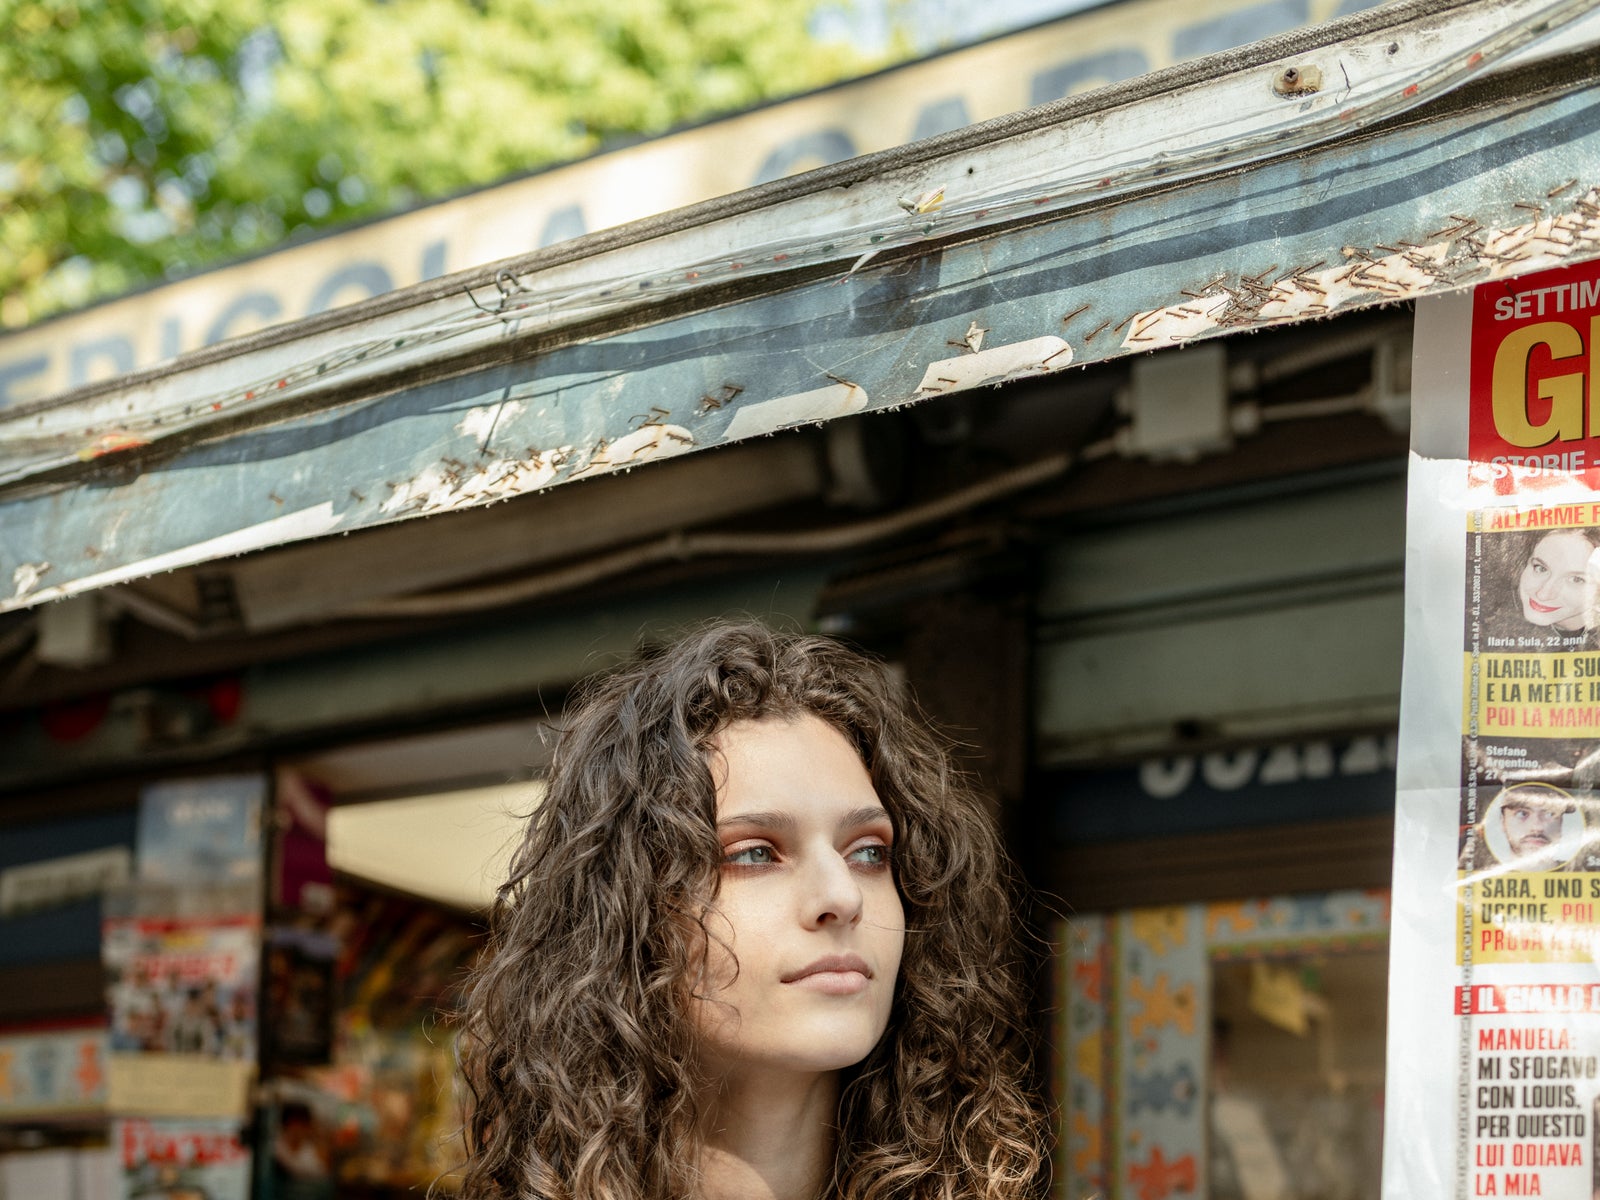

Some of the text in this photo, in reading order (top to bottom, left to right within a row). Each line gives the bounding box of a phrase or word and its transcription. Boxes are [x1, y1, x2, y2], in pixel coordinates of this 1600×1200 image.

[1491, 450, 1586, 479] STORIE
[1490, 504, 1585, 530] ALLARME
[1487, 636, 1515, 647] Ilaria
[1547, 636, 1561, 647] 22
[1487, 657, 1600, 681] ILARIA, IL SU
[1487, 683, 1495, 702] E
[1501, 684, 1522, 702] LA
[1528, 682, 1583, 703] METTE
[1486, 706, 1516, 726] POI
[1522, 707, 1543, 727] LA
[1486, 745, 1528, 757] Stefano
[1485, 757, 1542, 770] Argentino,
[1481, 878, 1536, 900] SARA,
[1544, 878, 1583, 899] UNO
[1481, 902, 1594, 925] UCCIDE, POI
[1478, 986, 1499, 1013] IL
[1479, 1056, 1598, 1080] MI SFOGAVO
[1478, 1085, 1582, 1110] CON LOUIS,
[1477, 1114, 1585, 1139] PER QUESTO
[1476, 1143, 1582, 1167] LUI ODIAVA
[1475, 1173, 1541, 1196] LA MIA
